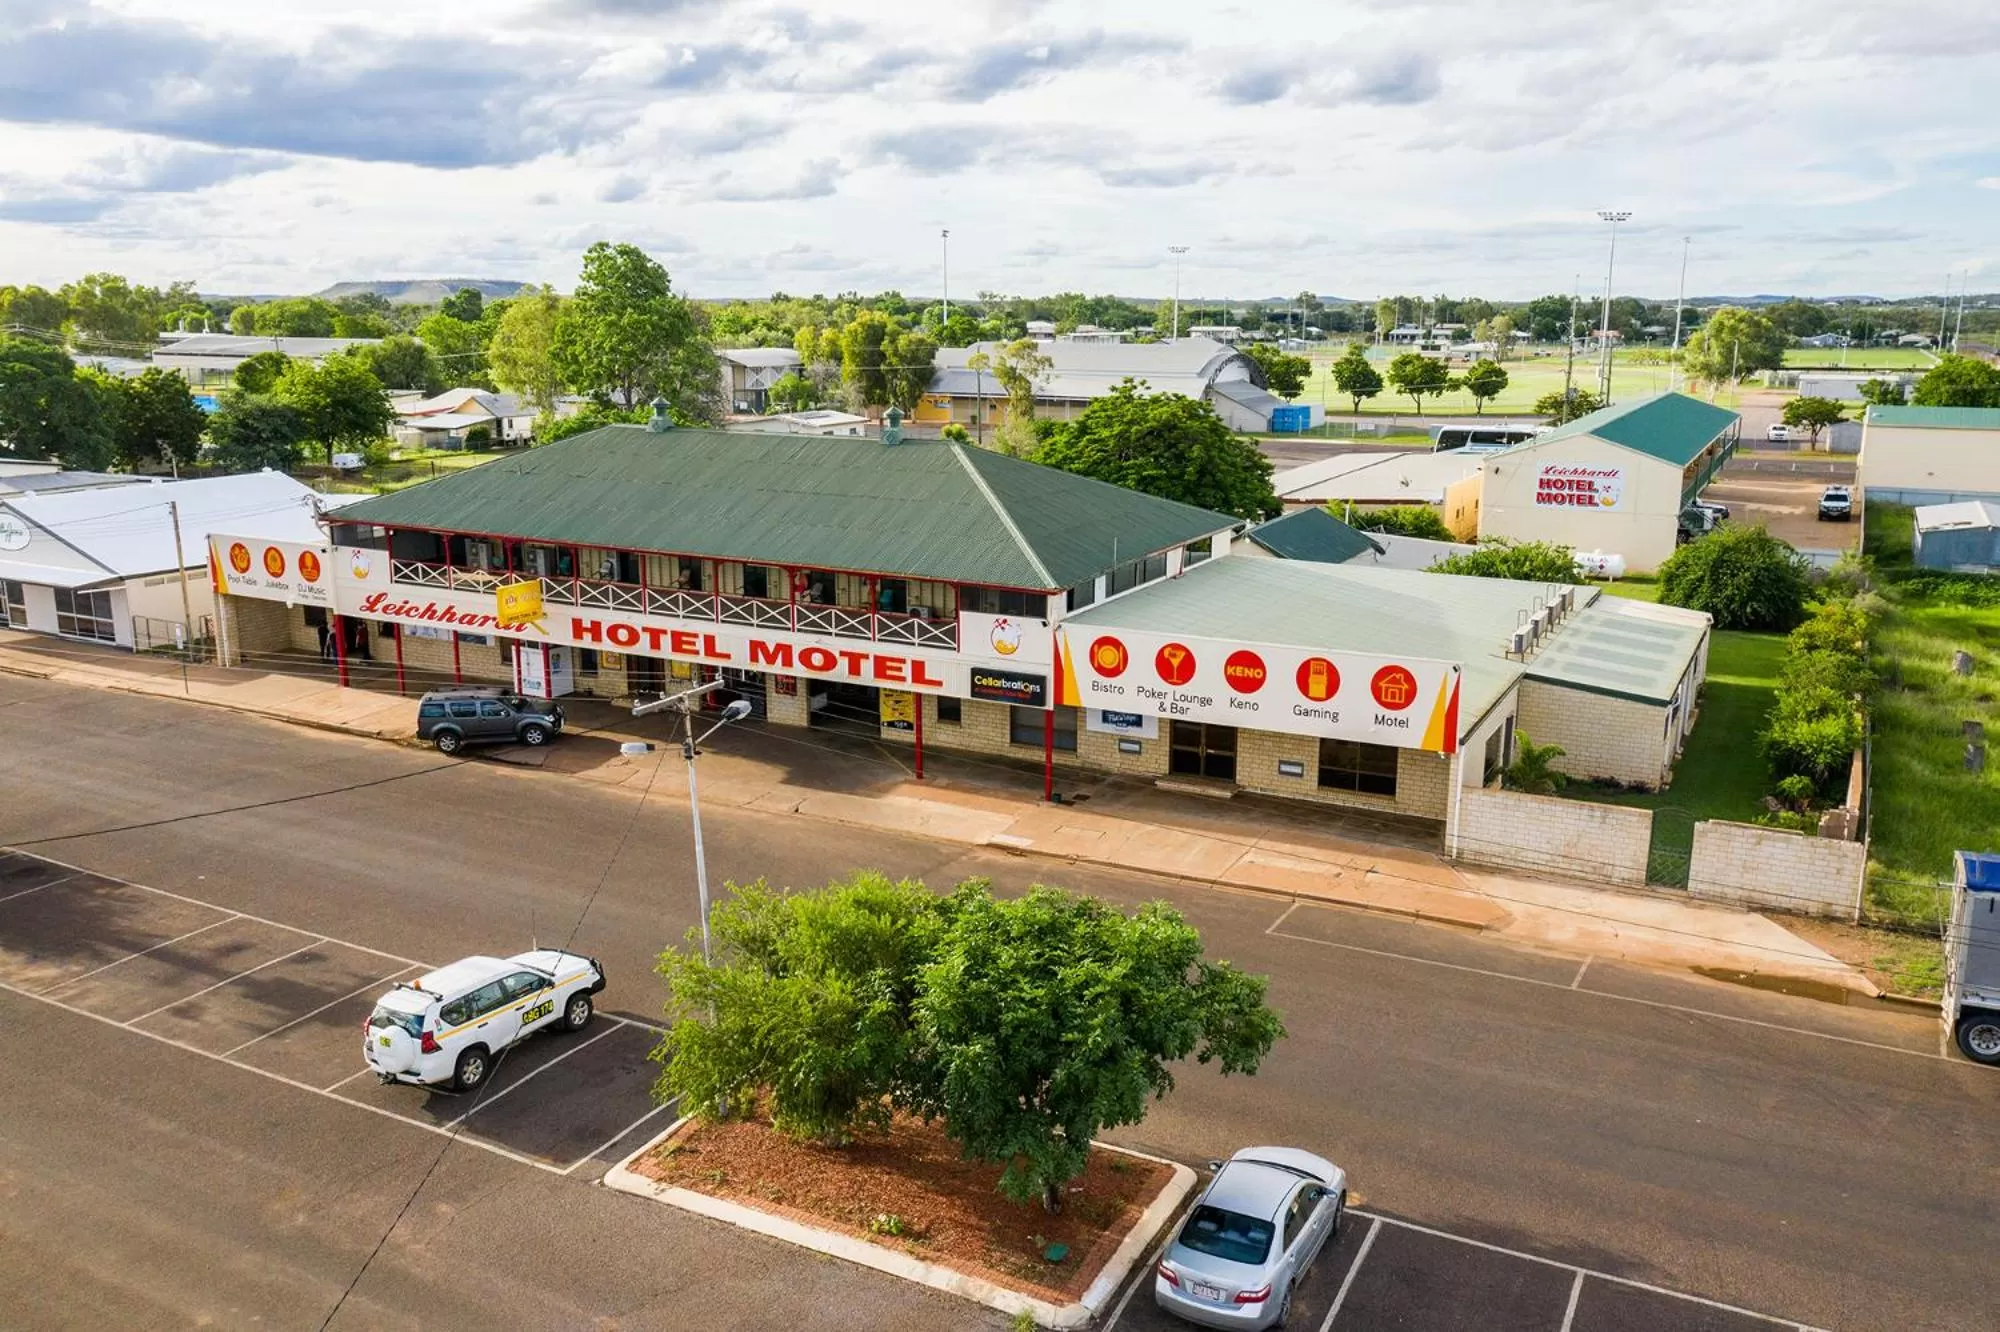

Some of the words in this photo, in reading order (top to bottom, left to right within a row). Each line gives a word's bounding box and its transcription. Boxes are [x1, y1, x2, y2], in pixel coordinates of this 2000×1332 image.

[1542, 464, 1619, 477] Leichhardt
[1538, 478, 1599, 493] HOTEL
[1536, 492, 1599, 507] MOTEL
[571, 618, 731, 660] HOTEL
[749, 640, 943, 687] MOTEL
[1226, 665, 1264, 679] KENO
[974, 675, 1041, 695] Cellarbrations
[1091, 680, 1125, 695] Bistro
[1136, 686, 1168, 700] Poker
[1172, 690, 1213, 707] Lounge
[1158, 702, 1167, 713] &
[1170, 702, 1190, 715] Bar
[1229, 697, 1260, 712] Keno
[1293, 704, 1340, 723] Gaming
[1374, 713, 1409, 728] Motel
